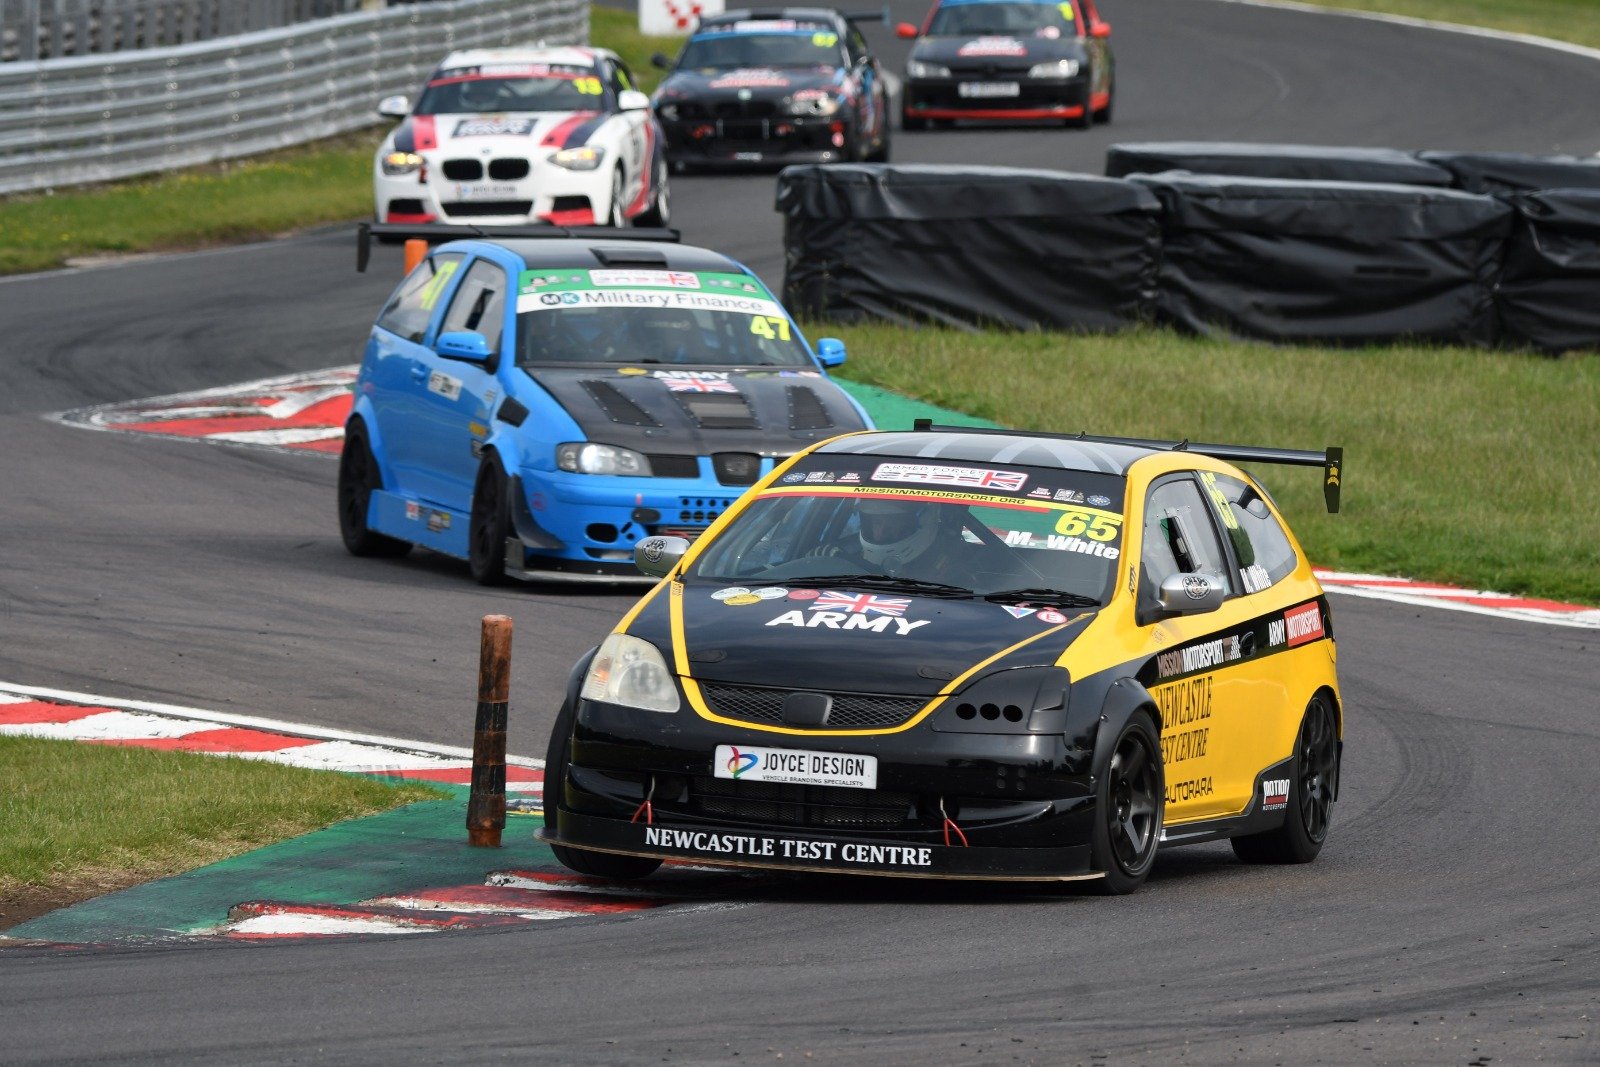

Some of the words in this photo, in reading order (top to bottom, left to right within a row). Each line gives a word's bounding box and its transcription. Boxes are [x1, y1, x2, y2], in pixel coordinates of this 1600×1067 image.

[586, 292, 670, 307] Military
[676, 293, 763, 312] Finance
[750, 315, 792, 341] 47
[653, 370, 729, 380] ARMY
[932, 467, 986, 475] FORCES
[1055, 511, 1121, 542] 65
[1004, 530, 1036, 547] M.
[1047, 534, 1120, 560] White
[764, 610, 932, 635] ARMY
[1268, 619, 1286, 647] ARMY
[1175, 728, 1210, 762] CENTRE
[762, 753, 806, 773] JOYCE
[812, 756, 865, 776] DESIGN
[789, 777, 822, 785] BRANDING
[823, 779, 864, 787] SPECIALISTS
[645, 827, 775, 856] NEWCASTLE
[779, 839, 837, 861] TEST
[841, 844, 932, 866] CENTRE
